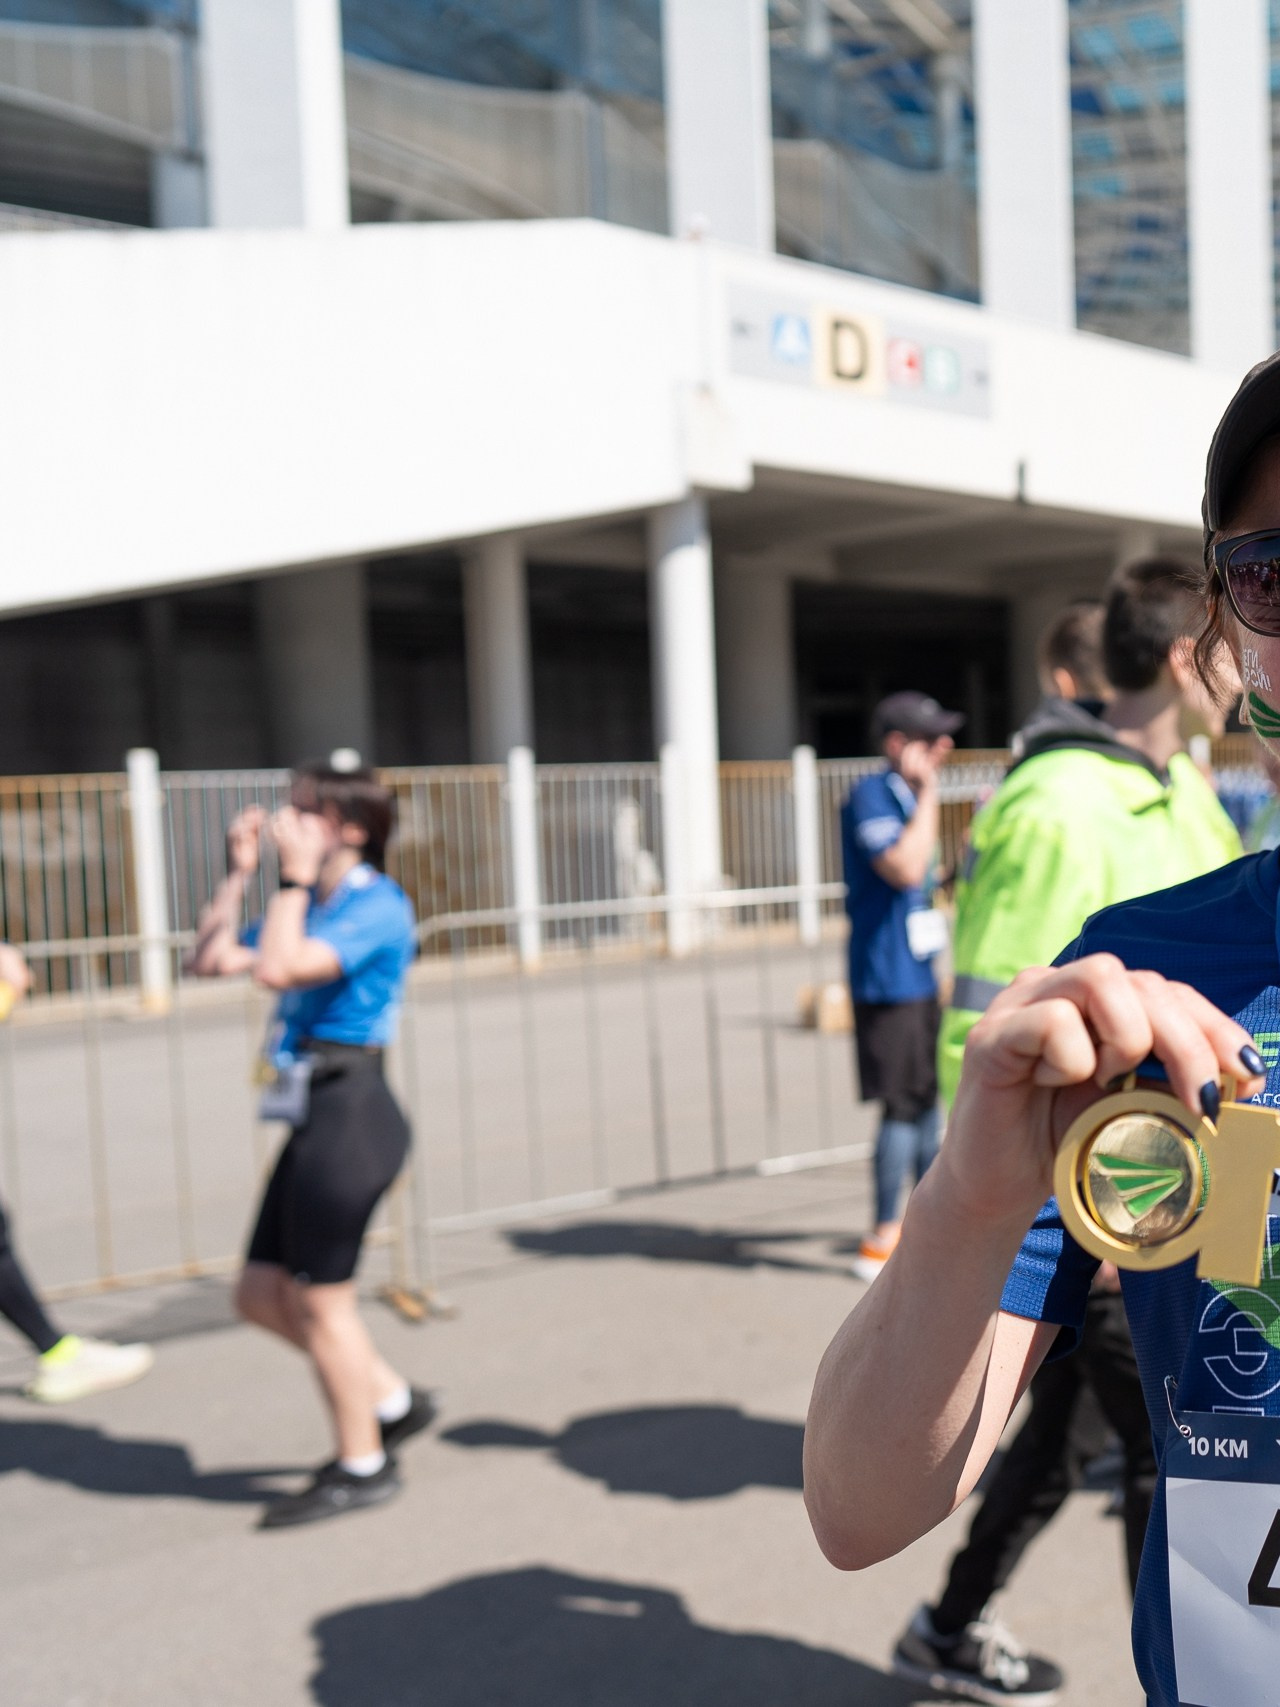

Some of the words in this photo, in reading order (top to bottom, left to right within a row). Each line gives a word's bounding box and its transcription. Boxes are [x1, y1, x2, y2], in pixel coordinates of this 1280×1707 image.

[830, 317, 869, 380] D
[1188, 1436, 1210, 1456] 10
[1214, 1438, 1248, 1459] КМ
